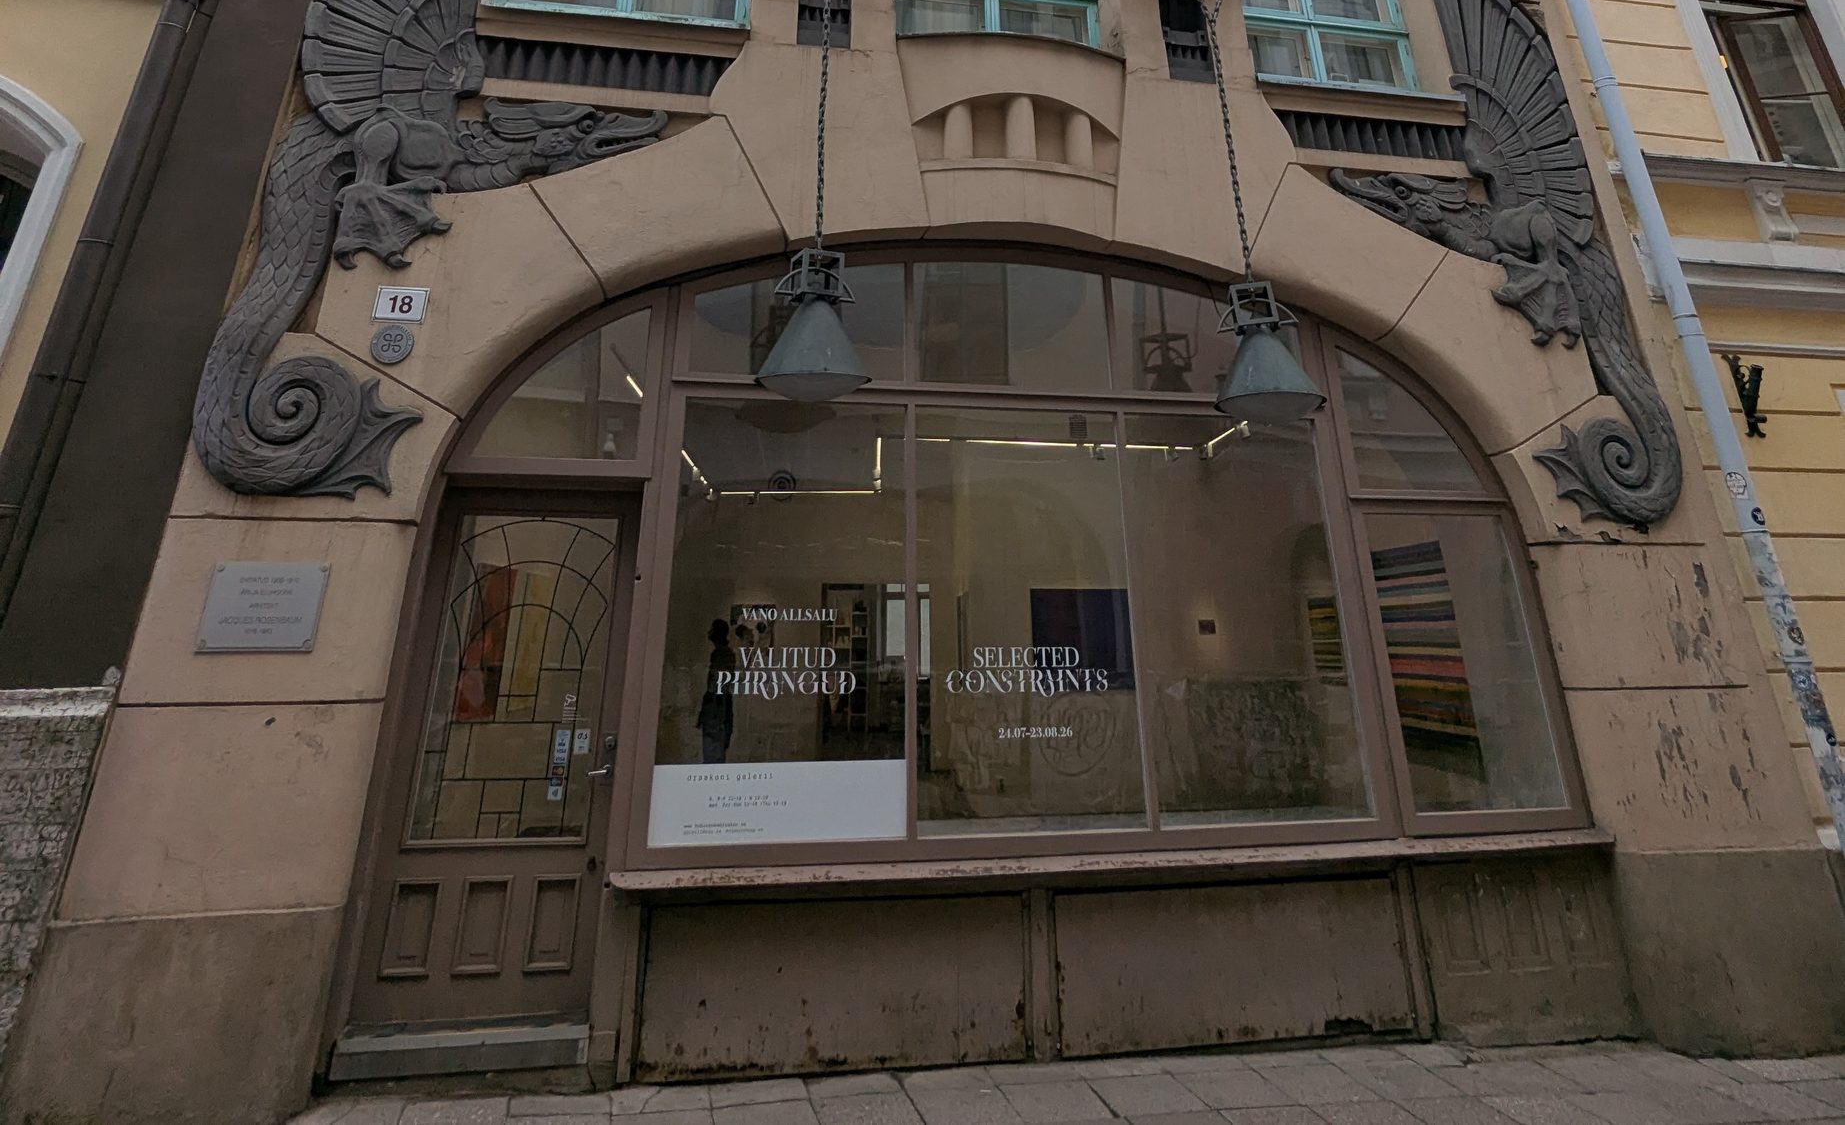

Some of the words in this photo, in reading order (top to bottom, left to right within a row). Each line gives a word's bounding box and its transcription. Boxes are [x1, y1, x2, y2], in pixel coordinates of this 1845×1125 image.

[388, 295, 413, 314] 18
[742, 608, 777, 621] VANO
[780, 608, 838, 621] ALLSALU
[740, 647, 836, 669] VALITUD
[973, 646, 1080, 668] SELECTED
